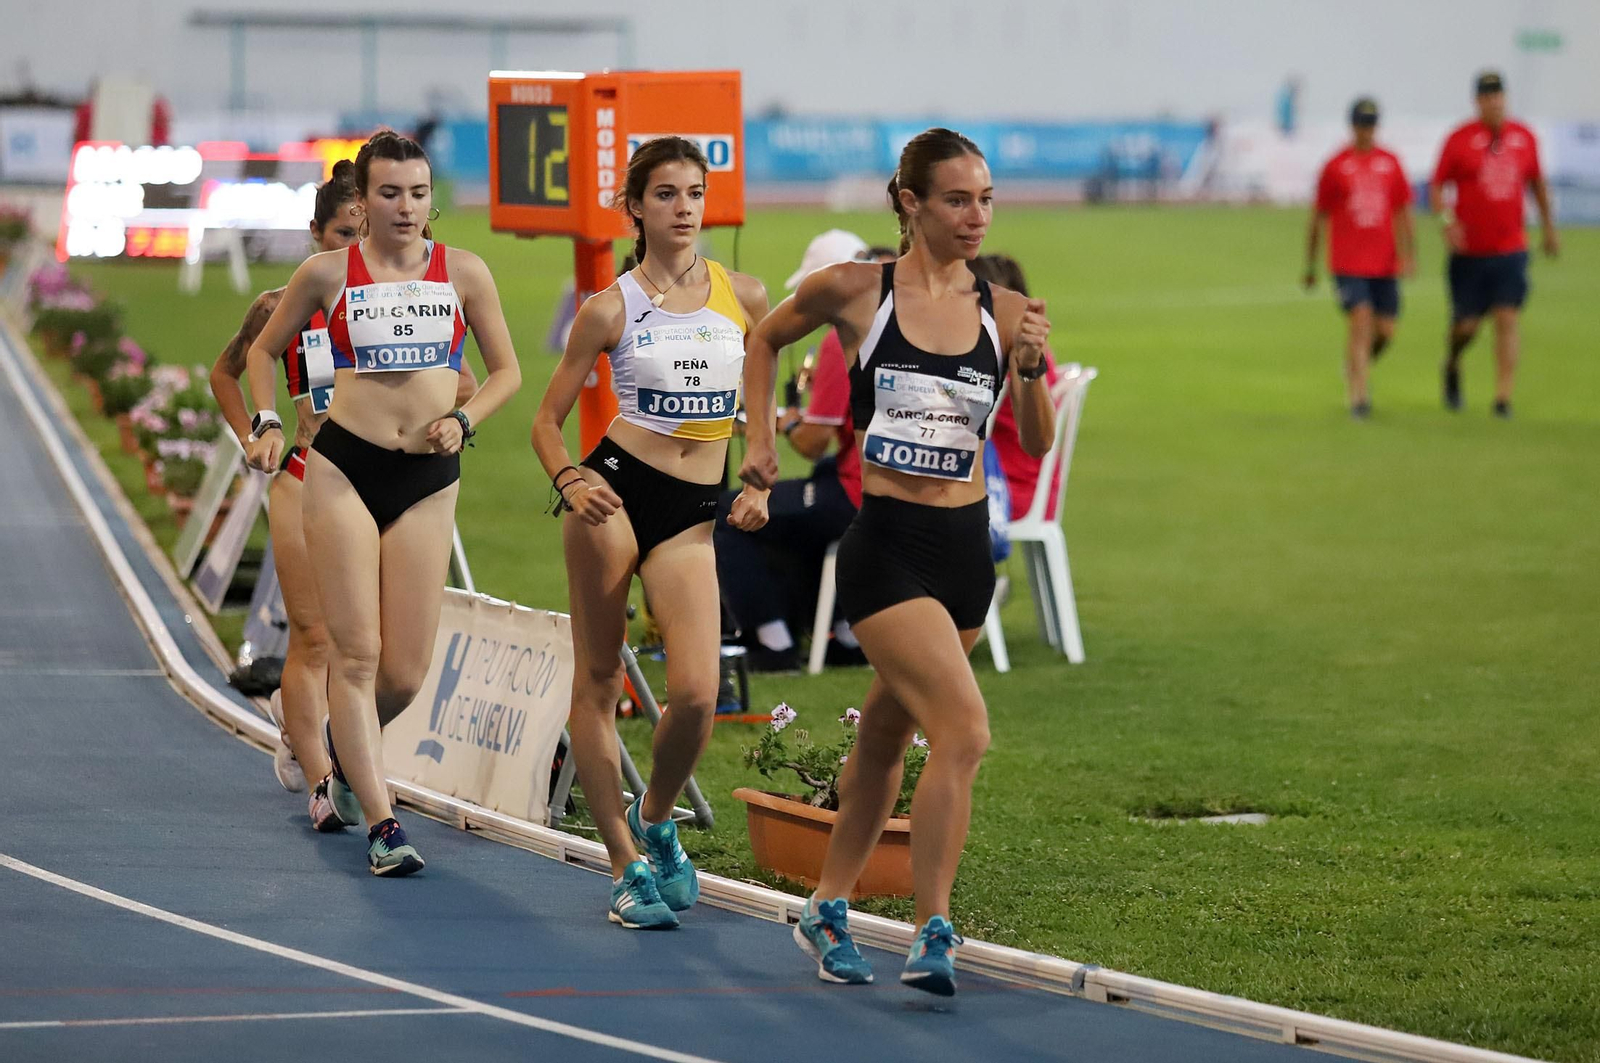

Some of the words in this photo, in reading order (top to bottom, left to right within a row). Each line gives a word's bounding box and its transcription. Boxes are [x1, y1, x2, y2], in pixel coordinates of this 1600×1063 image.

[597, 108, 616, 208] MONDO
[366, 283, 406, 294] DIPACIÓN
[353, 304, 451, 321] PULGARIN
[393, 324, 414, 336] 85
[674, 358, 709, 370] PEÑA
[684, 376, 701, 387] 78
[908, 385, 936, 394] HUELVA
[920, 427, 936, 439] 77
[448, 695, 470, 742] DE
[467, 699, 528, 757] HUELVA
